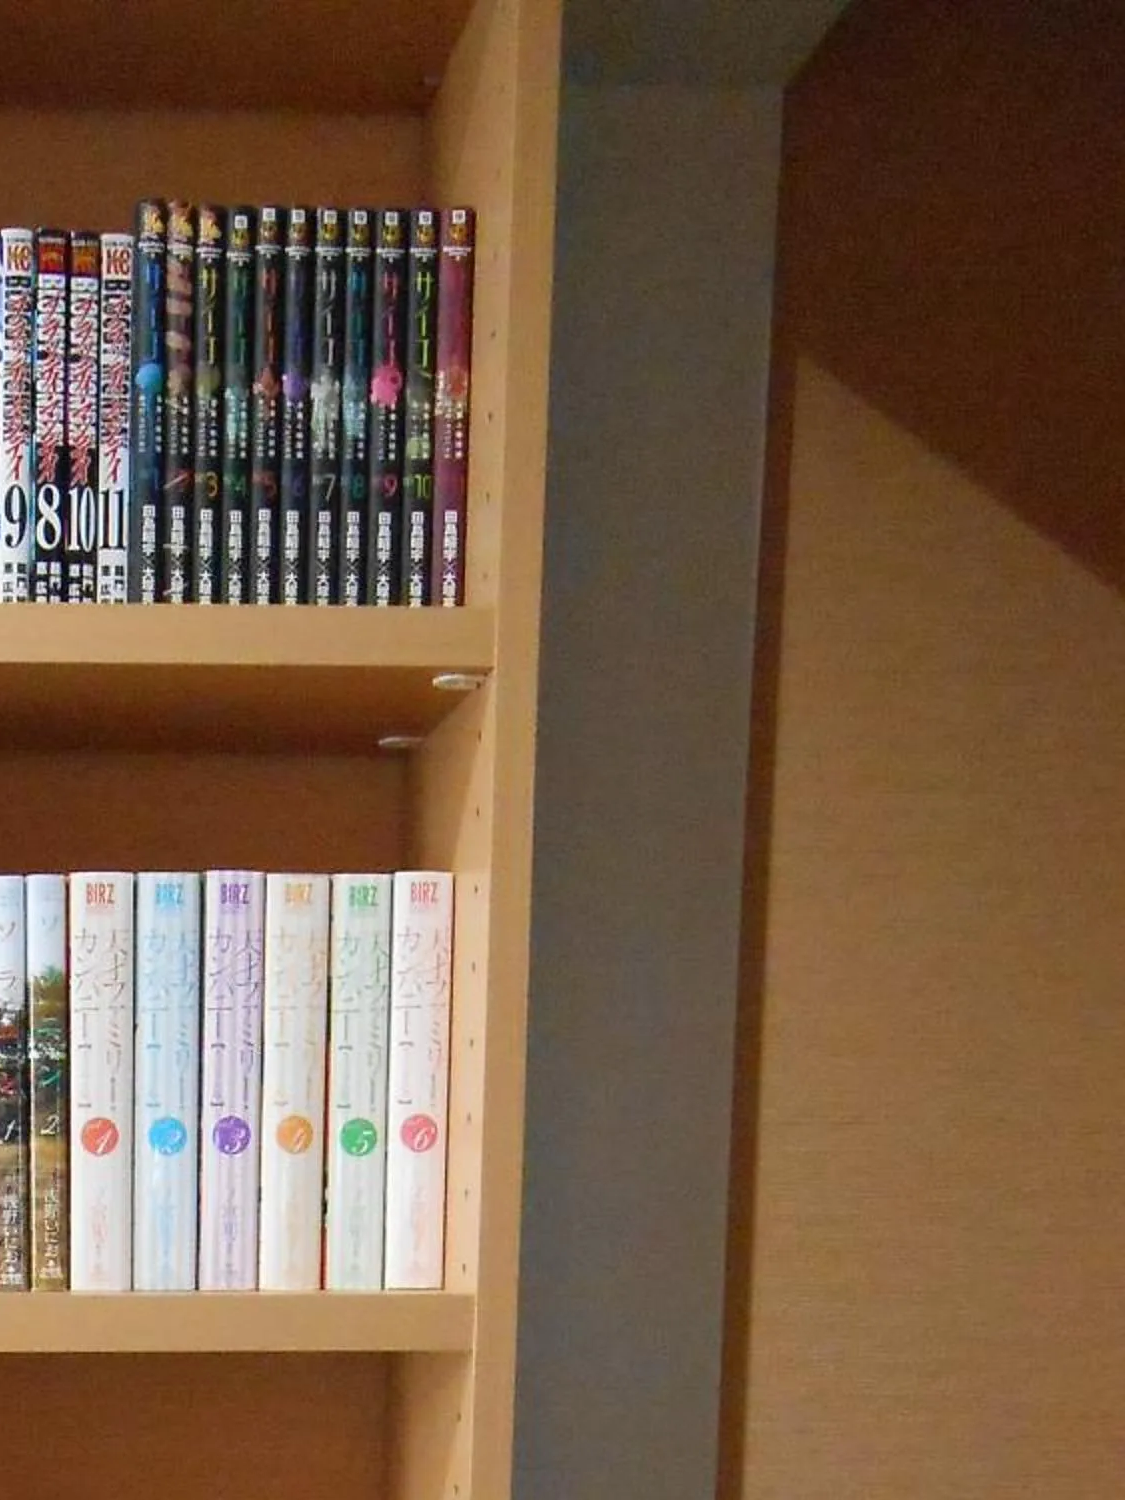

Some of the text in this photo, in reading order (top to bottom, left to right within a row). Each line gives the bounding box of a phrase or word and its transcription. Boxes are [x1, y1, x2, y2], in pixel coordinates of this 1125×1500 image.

[4, 484, 26, 546] 9
[37, 484, 62, 549] 8
[68, 486, 96, 550] 10
[99, 489, 124, 548] 11
[86, 883, 115, 904] BIRZ
[155, 885, 184, 904] BIRZ
[220, 884, 250, 903] BIRZ
[285, 884, 313, 903] BIRZ
[349, 885, 378, 906] BIRZ
[410, 882, 438, 902] BIRZ
